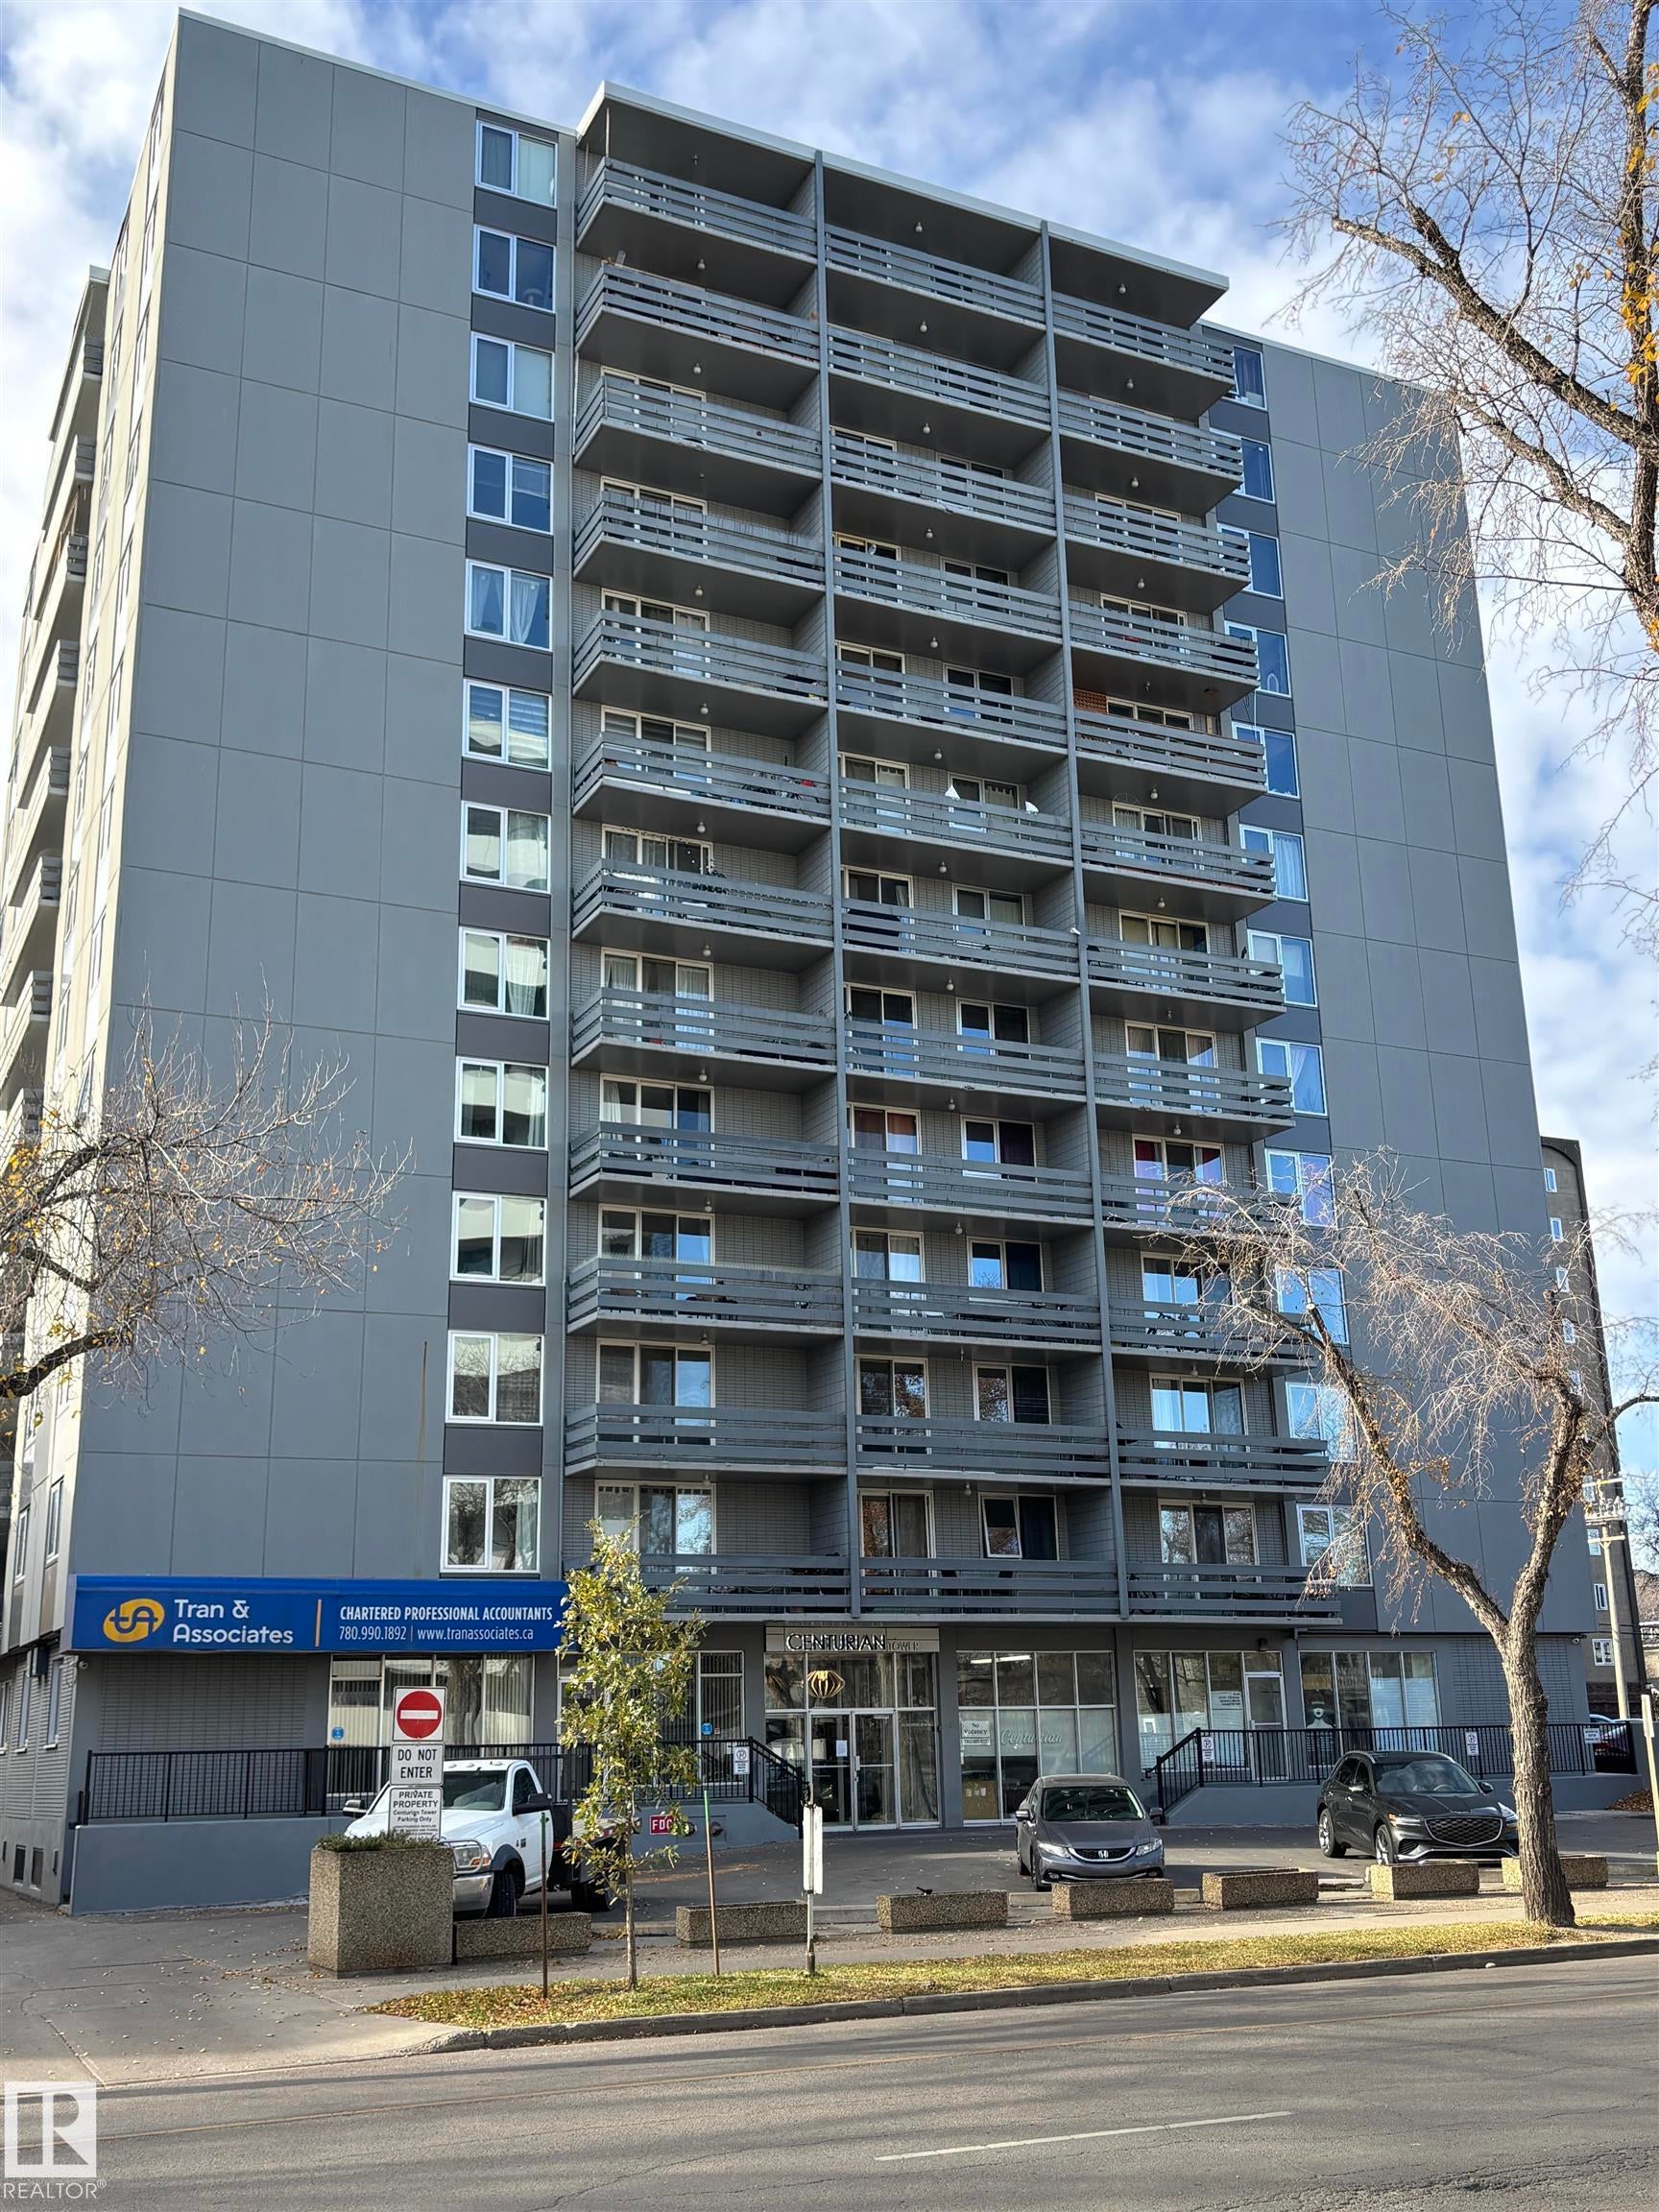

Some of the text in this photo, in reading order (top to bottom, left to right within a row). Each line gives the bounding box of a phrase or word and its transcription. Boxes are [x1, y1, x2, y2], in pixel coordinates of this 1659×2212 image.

[174, 1599, 251, 1620] Tran &
[340, 1606, 553, 1621] CHARTERED PROFESSIONAL ACCOUNTANTS
[173, 1623, 294, 1644] Associates
[339, 1625, 534, 1641] 780.990.1892 www.tranassociates.ca
[785, 1632, 919, 1651] CENTURIAN TOWER
[397, 1749, 437, 1761] DO NOT
[400, 1767, 433, 1779] ENTER
[398, 1791, 434, 1799] PRIVATE
